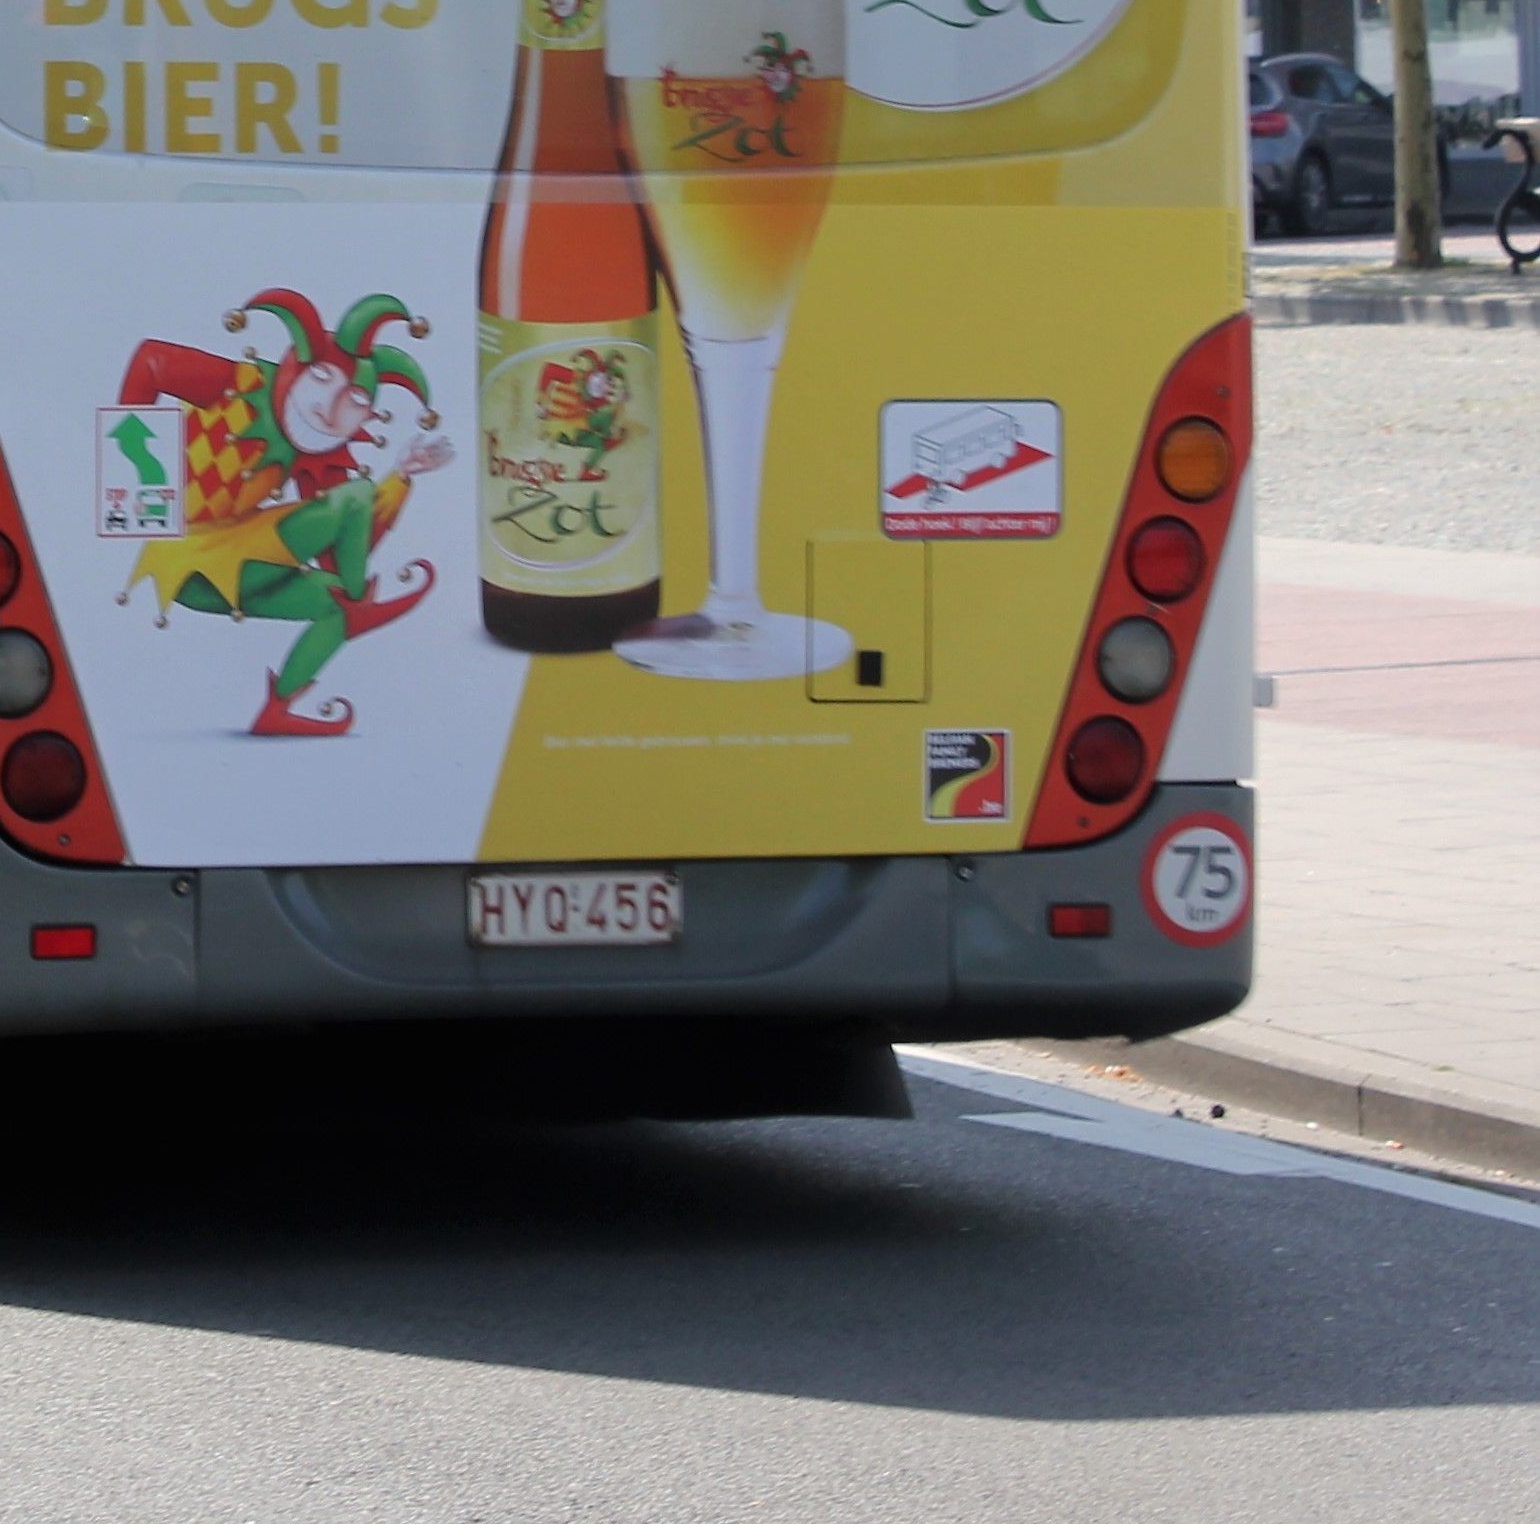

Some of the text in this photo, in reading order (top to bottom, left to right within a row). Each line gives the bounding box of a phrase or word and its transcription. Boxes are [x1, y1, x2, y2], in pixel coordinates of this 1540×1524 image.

[43, 61, 341, 155] BIER!
[491, 486, 626, 544] Zot
[1172, 845, 1232, 899] 75
